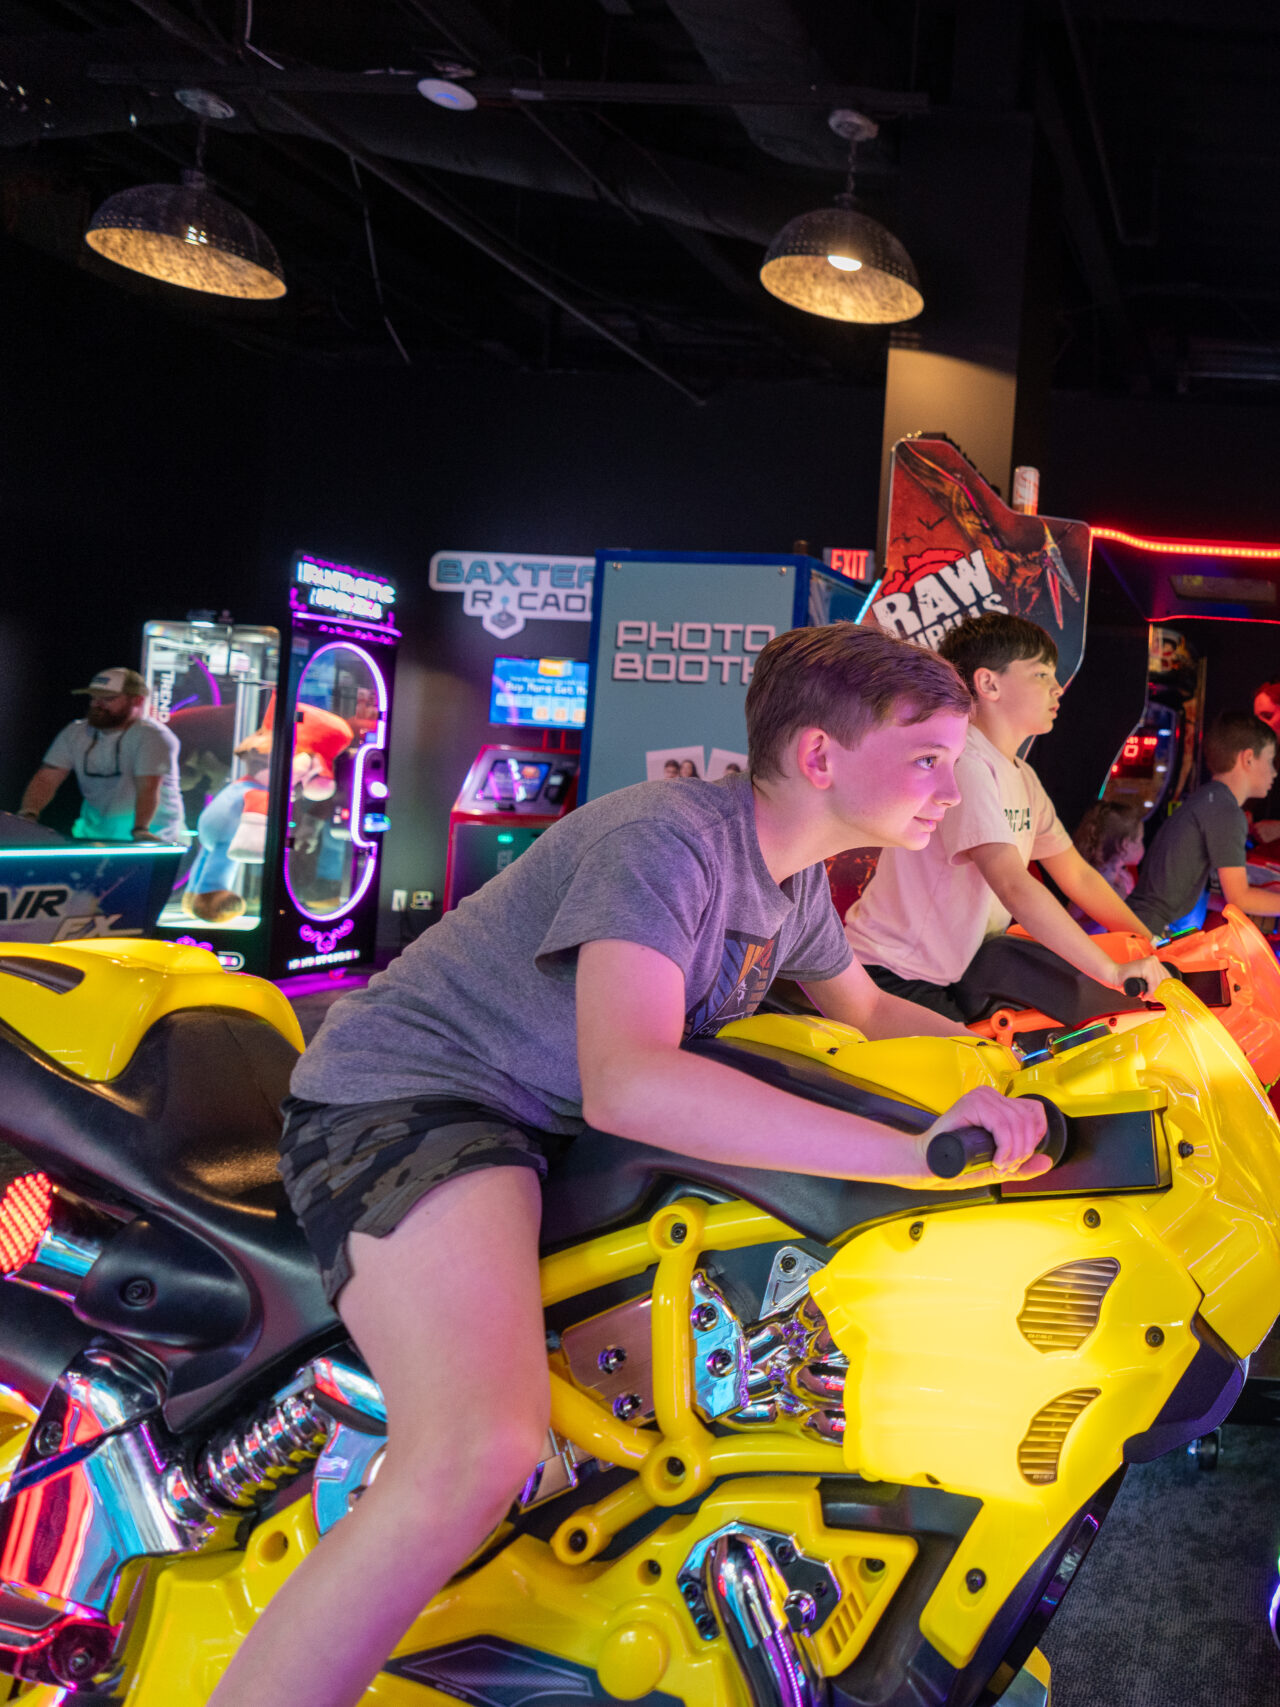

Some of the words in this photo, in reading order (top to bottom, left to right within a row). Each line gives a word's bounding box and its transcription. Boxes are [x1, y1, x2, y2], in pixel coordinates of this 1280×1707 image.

[830, 549, 869, 580] EXIT
[518, 592, 592, 613] CAD
[872, 550, 994, 639] RAW
[616, 620, 776, 652] PHOTO
[0, 886, 69, 921] IR
